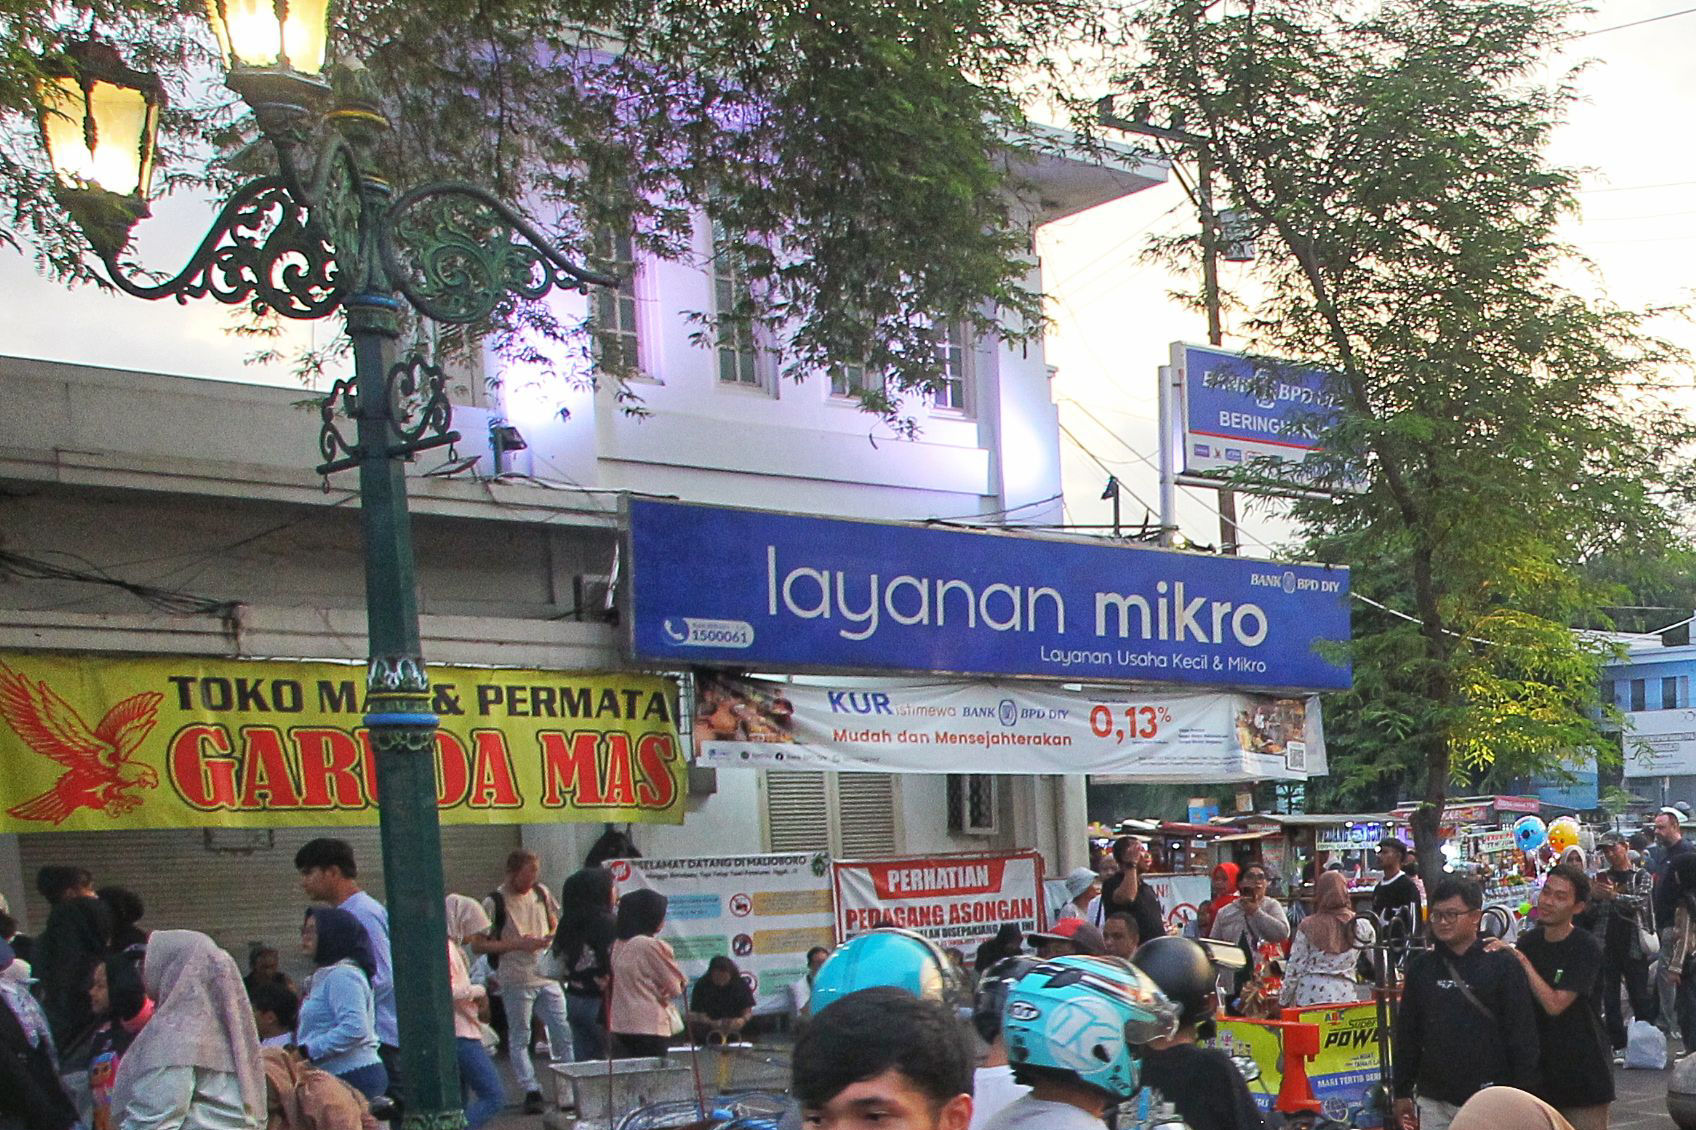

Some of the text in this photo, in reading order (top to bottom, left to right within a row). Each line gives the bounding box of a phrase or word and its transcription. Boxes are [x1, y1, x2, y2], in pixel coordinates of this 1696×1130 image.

[768, 545, 1268, 647] layanan mikro
[1250, 573, 1340, 593] BANK BPD DIY
[692, 630, 747, 643] 1500061
[1040, 645, 1266, 673] Layanan Usaha Kecil & Mikro
[168, 676, 304, 713] TOKO
[432, 684, 465, 716] &
[477, 684, 670, 723] PERMATA
[828, 690, 894, 715] KUR
[962, 707, 996, 718] BANK
[1020, 708, 1045, 719] BPD
[1048, 709, 1069, 720] DIY
[1089, 704, 1172, 744] 0,13%
[833, 729, 1072, 749] Mudah dan Mensejahterakan
[167, 722, 677, 812] GARDA MAS
[687, 857, 732, 869] DATANG
[734, 857, 746, 867] DI
[887, 865, 989, 892] PERHATIAN
[845, 904, 945, 930] PEDAGANG
[949, 898, 1034, 924] ASONGAN
